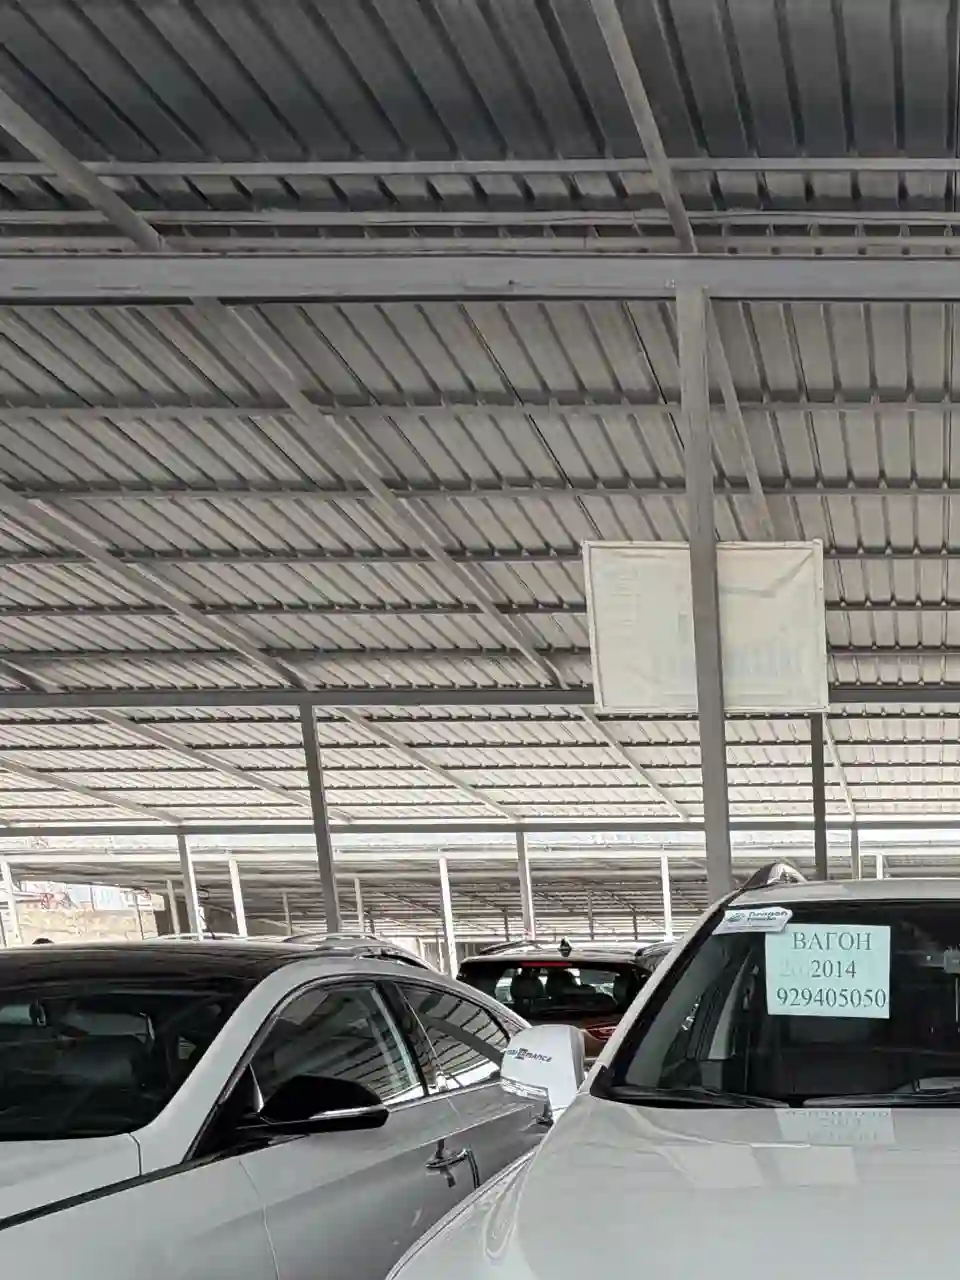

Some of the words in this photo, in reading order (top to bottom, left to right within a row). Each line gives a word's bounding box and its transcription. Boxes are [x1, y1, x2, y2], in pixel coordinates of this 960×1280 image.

[792, 931, 873, 951] ВАГОН
[810, 959, 857, 979] 2014
[776, 987, 887, 1009] 929405050
